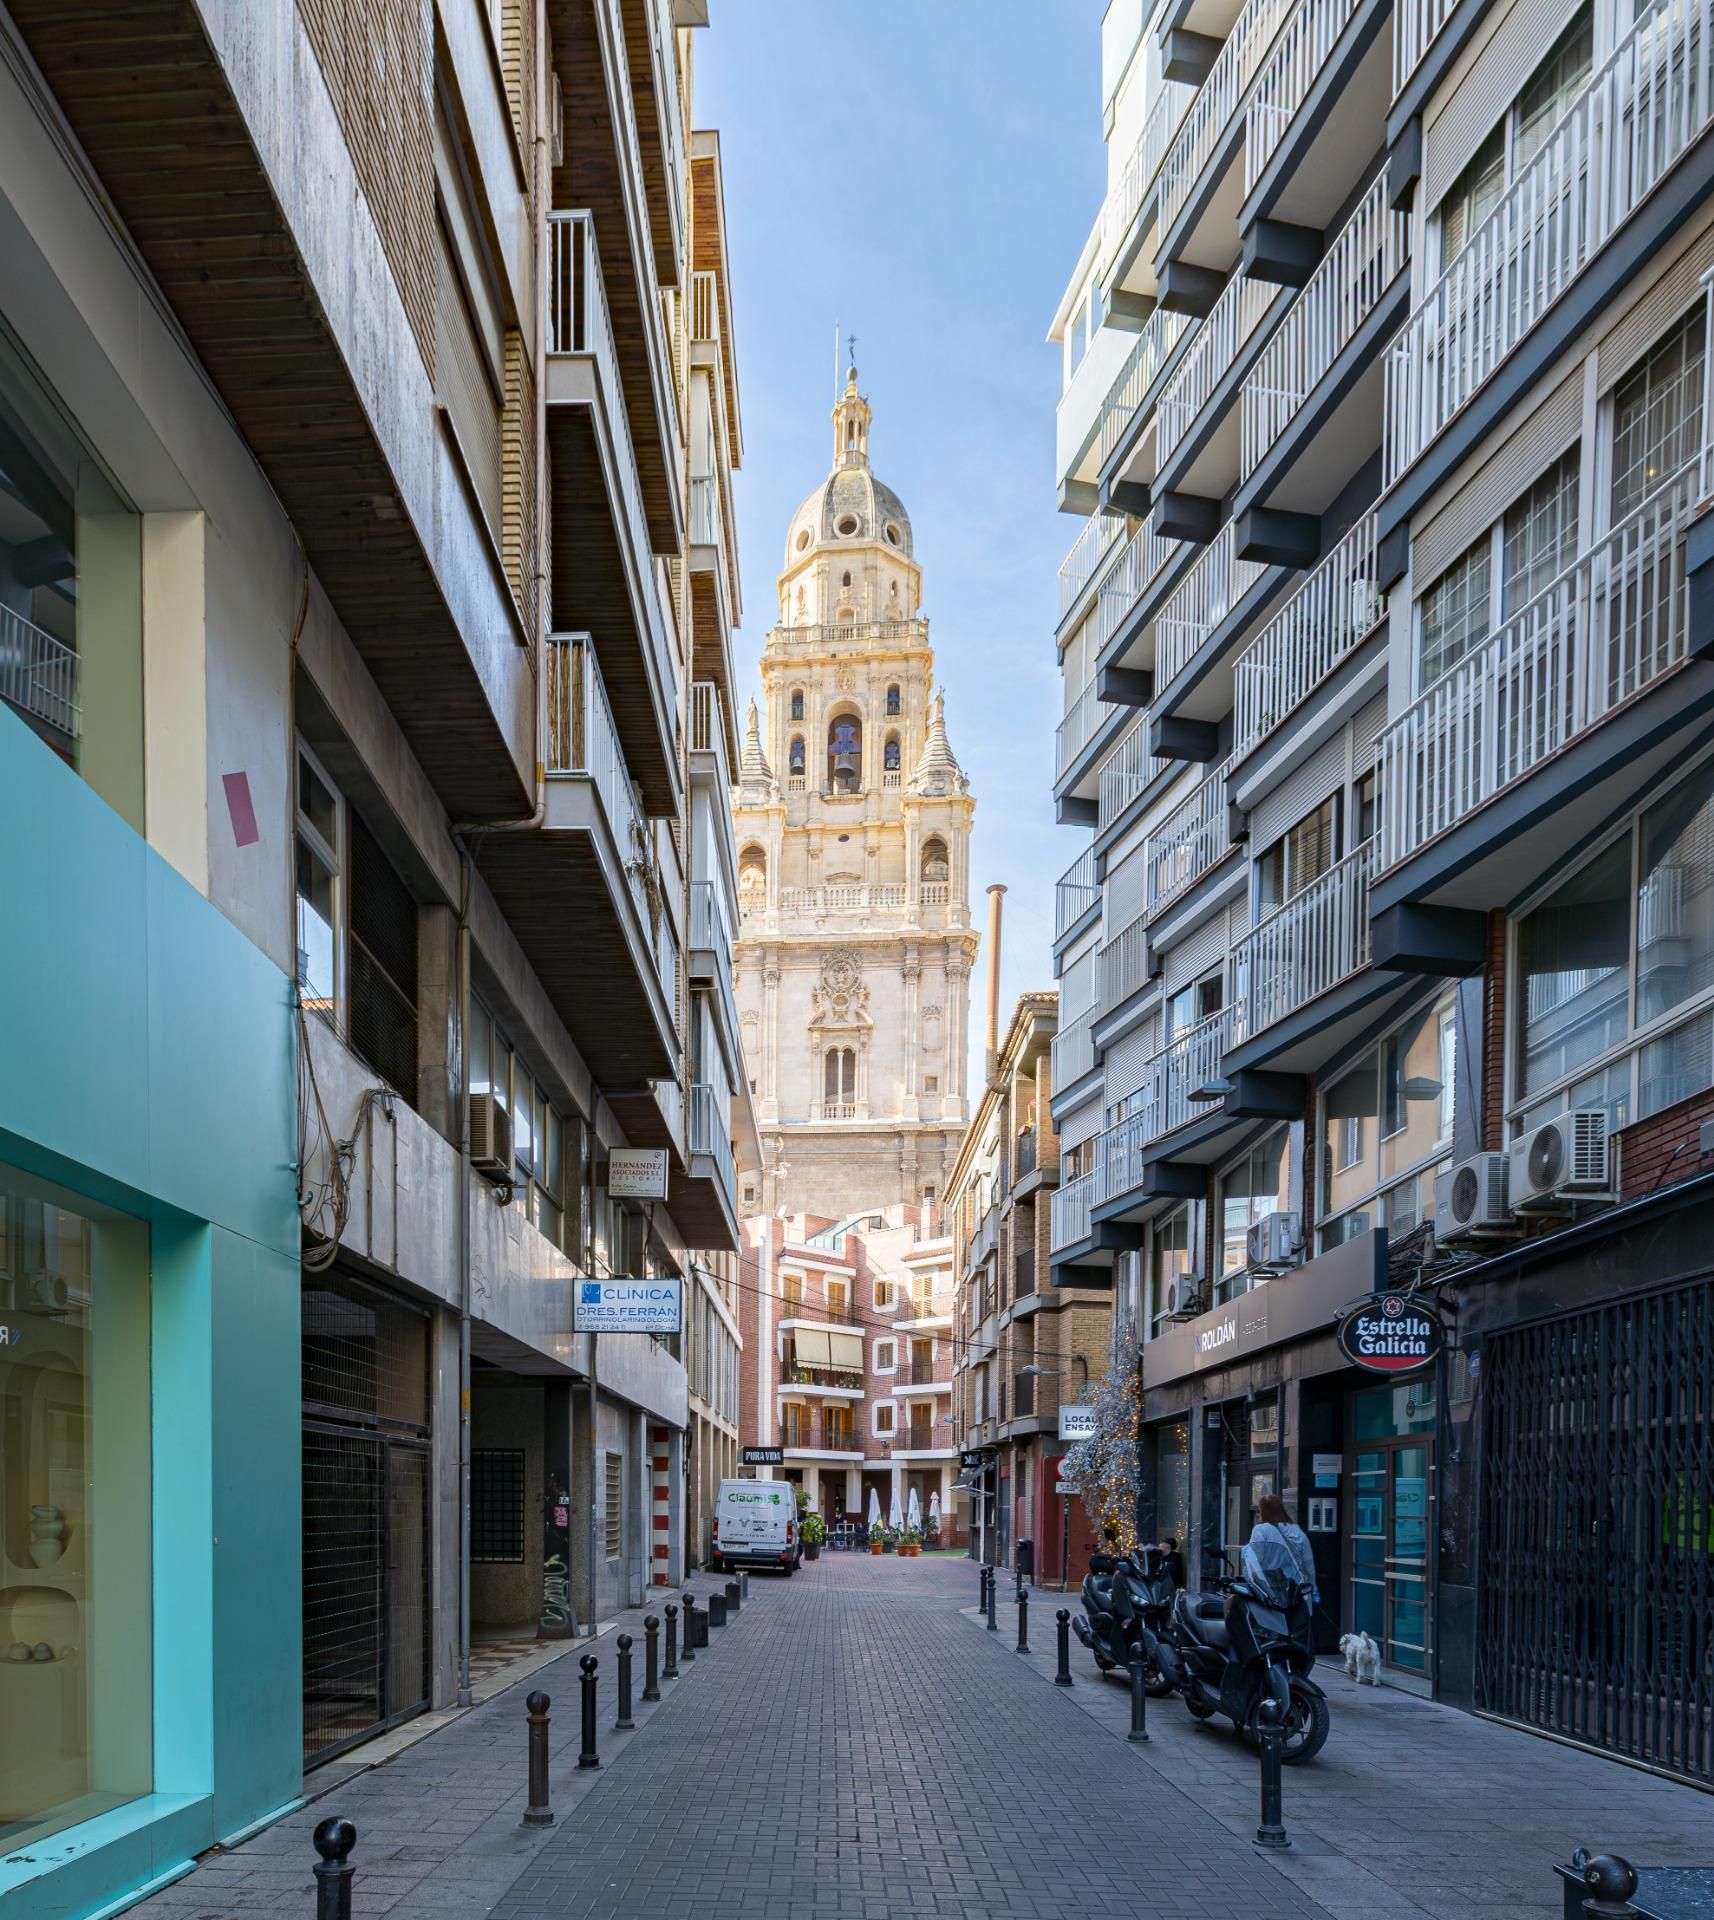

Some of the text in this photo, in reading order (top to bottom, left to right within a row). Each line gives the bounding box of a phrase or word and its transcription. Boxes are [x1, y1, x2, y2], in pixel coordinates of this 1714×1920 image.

[603, 1287, 674, 1300] CLÍNICA
[1201, 1316, 1236, 1353] ROLDÁN
[1355, 1316, 1431, 1336] Estrella
[1359, 1335, 1427, 1355] Galicia
[745, 1451, 781, 1461] PURA VIDA
